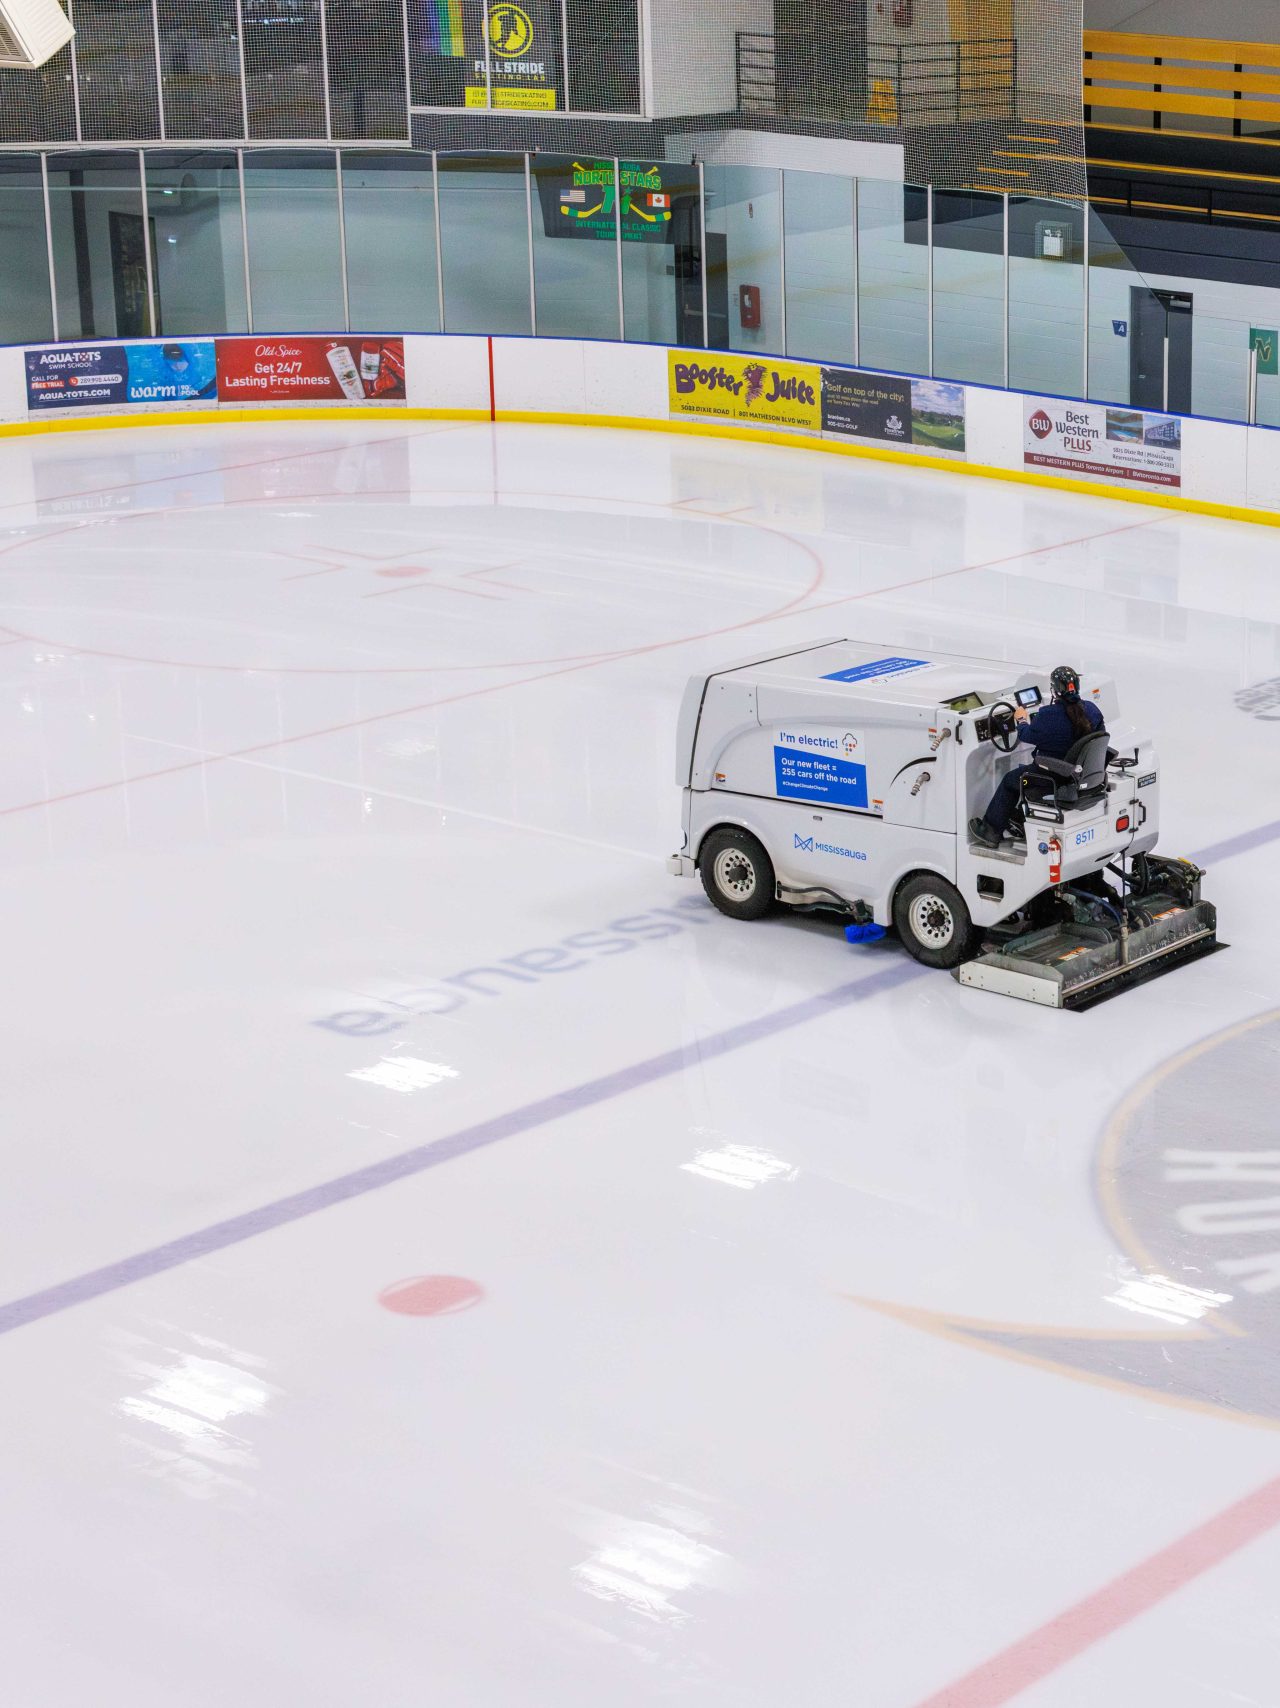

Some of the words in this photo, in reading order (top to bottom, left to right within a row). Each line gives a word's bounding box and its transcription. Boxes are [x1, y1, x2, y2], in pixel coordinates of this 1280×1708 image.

[504, 61, 545, 74] STRIDE
[573, 170, 616, 187] NORTH
[619, 171, 662, 191] STARS
[40, 351, 101, 365] AQUA-TOTS
[255, 345, 275, 357] Old
[275, 345, 302, 358] Spice
[254, 362, 275, 374] Get
[276, 362, 302, 374] 24/7
[31, 381, 47, 390] FREE
[48, 380, 65, 388] TRIAL
[225, 375, 268, 389] Lasting
[270, 373, 331, 386] Freshness
[674, 363, 744, 396] Booster
[38, 388, 111, 401] AQUA-TOTS.COM
[130, 385, 177, 399] warm
[765, 371, 816, 406] Juice
[826, 383, 842, 393] Golf
[842, 386, 853, 394] on
[853, 387, 866, 398] top
[867, 389, 876, 398] of
[876, 390, 888, 400] the
[695, 406, 712, 414] DIXIE
[712, 407, 730, 415] ROAD
[749, 411, 781, 422] MATHESON
[781, 415, 796, 424] BLVD
[796, 417, 812, 426] WEST
[1066, 410, 1089, 426] Best
[1032, 418, 1050, 432] BW
[1055, 421, 1100, 440] Western
[1063, 436, 1093, 452] PLUS
[1033, 455, 1046, 463] BEST
[1046, 457, 1071, 467] WESTERN
[1071, 460, 1085, 470] PLUS
[1085, 463, 1105, 472] Toronto
[1105, 465, 1124, 476] Airport
[780, 731, 795, 743] I'm
[798, 734, 839, 749] electric!
[781, 757, 795, 766] Our
[796, 760, 812, 769] new
[813, 761, 831, 771] fleet
[782, 767, 796, 777] 255
[797, 770, 813, 779] cars
[814, 772, 825, 781] off
[826, 773, 839, 783] the
[839, 776, 857, 785] road
[1075, 828, 1094, 846] 8511
